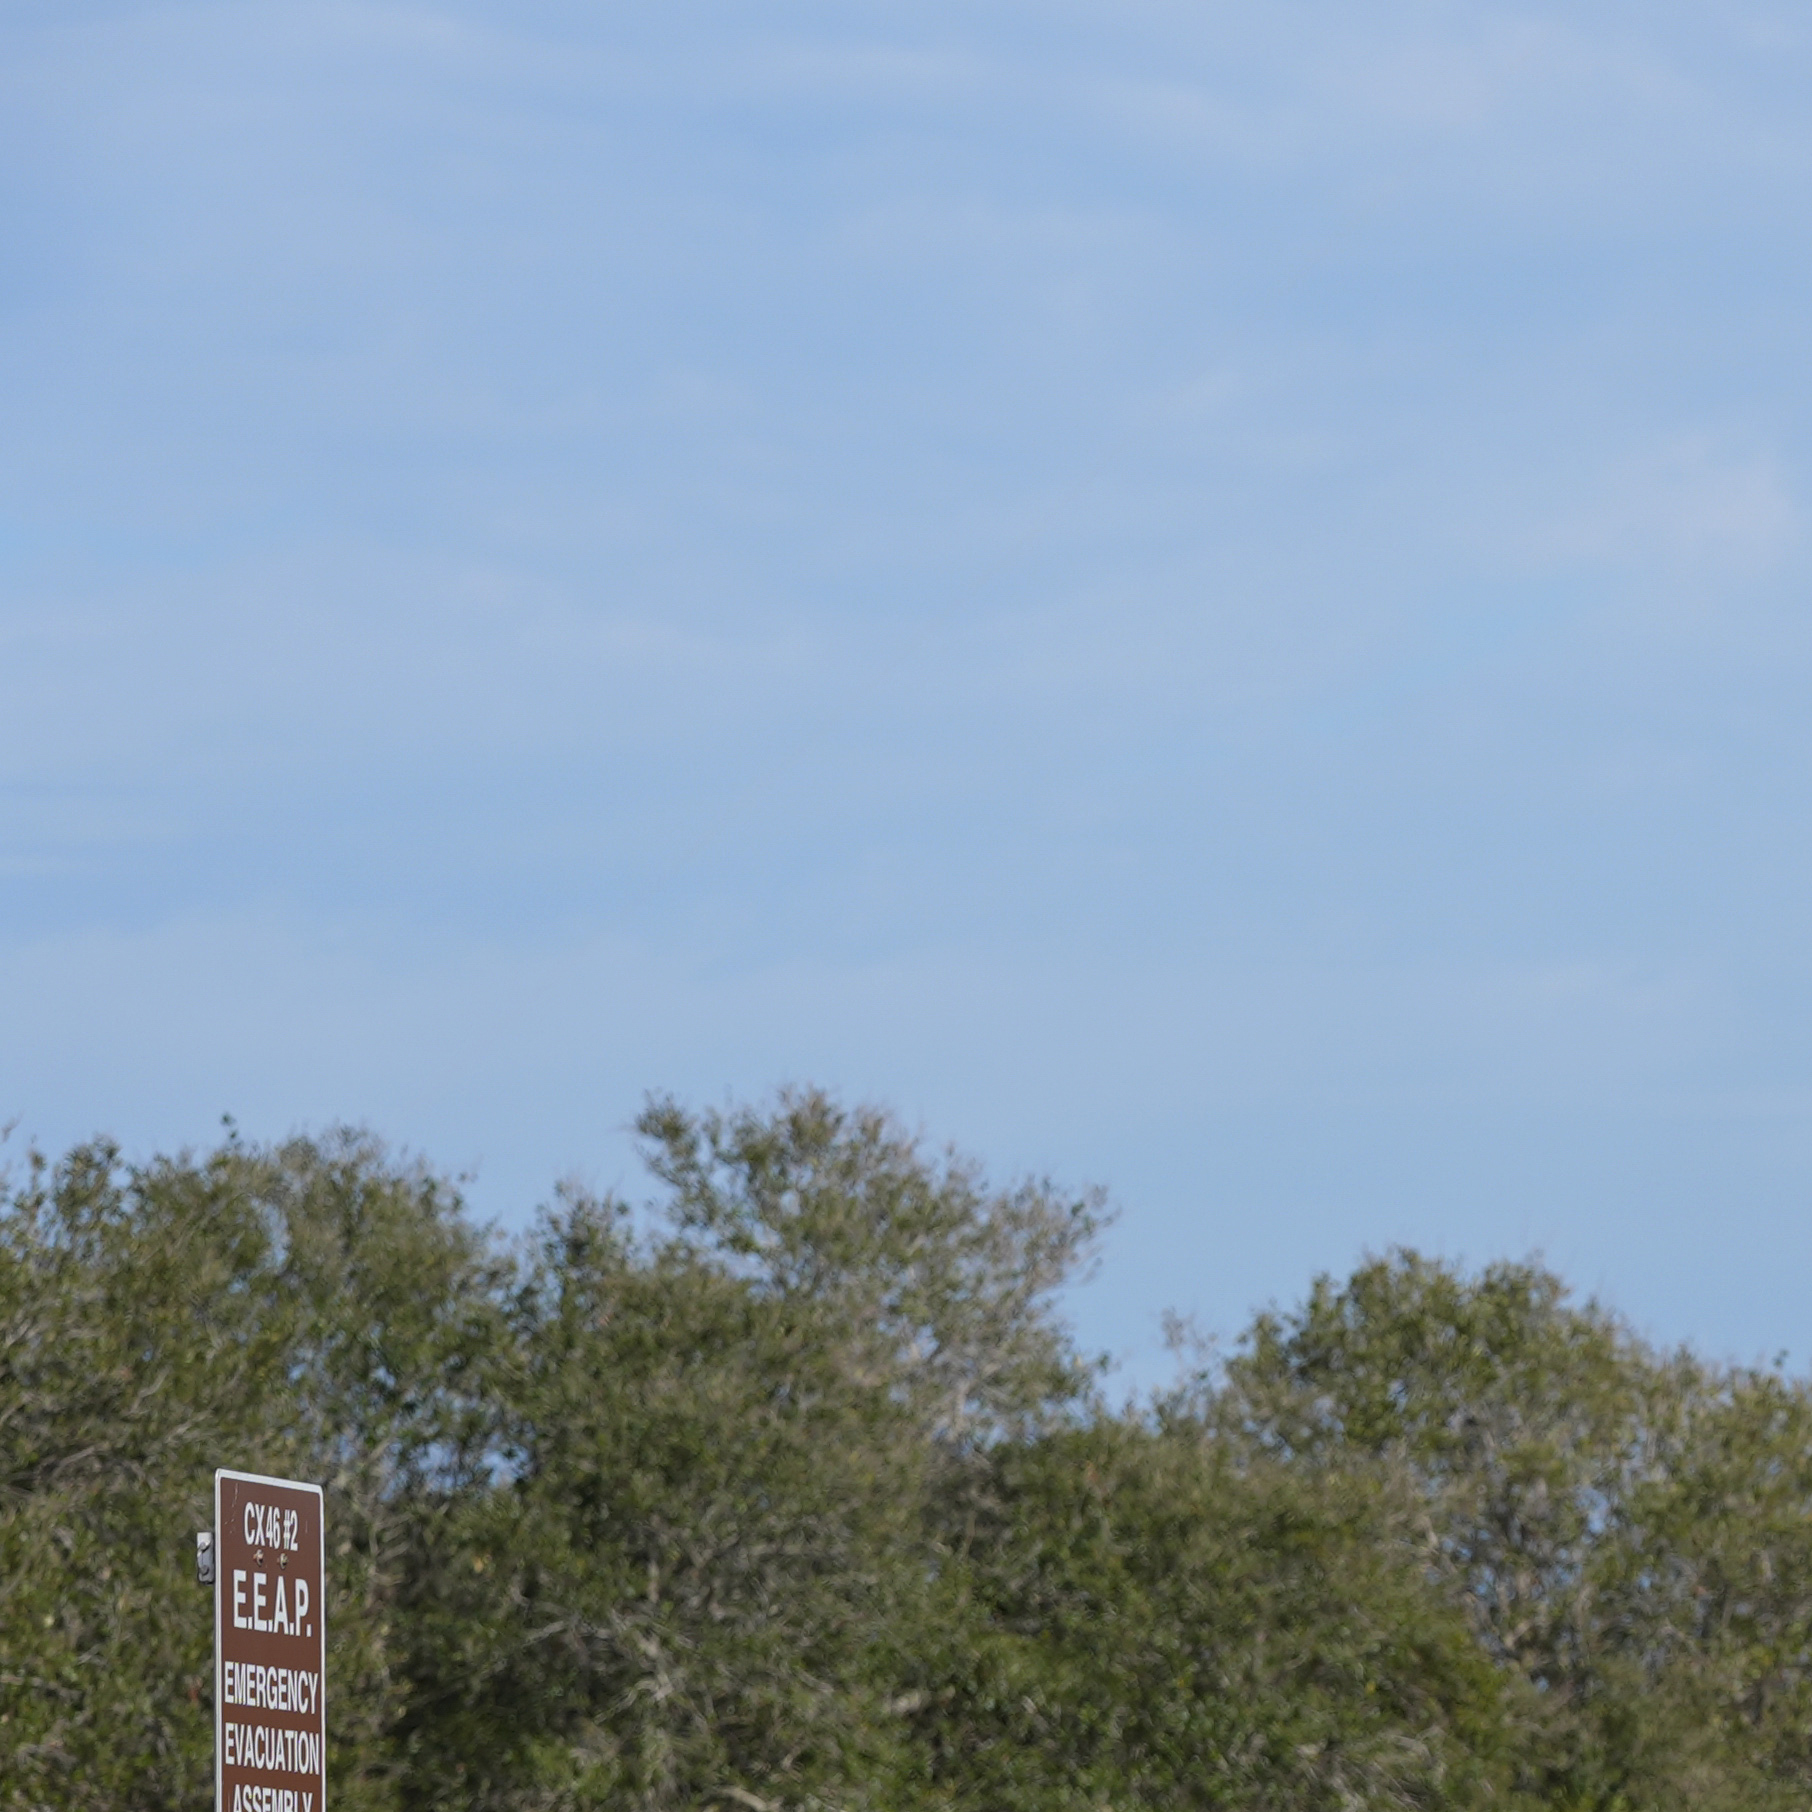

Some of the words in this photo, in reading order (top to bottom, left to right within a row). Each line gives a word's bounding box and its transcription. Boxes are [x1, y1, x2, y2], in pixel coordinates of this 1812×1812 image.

[283, 1509, 298, 1551] #2
[233, 1569, 312, 1637] E.E.A.P.
[224, 1660, 319, 1714] EMERGENCY
[225, 1722, 320, 1775] EVACUATION
